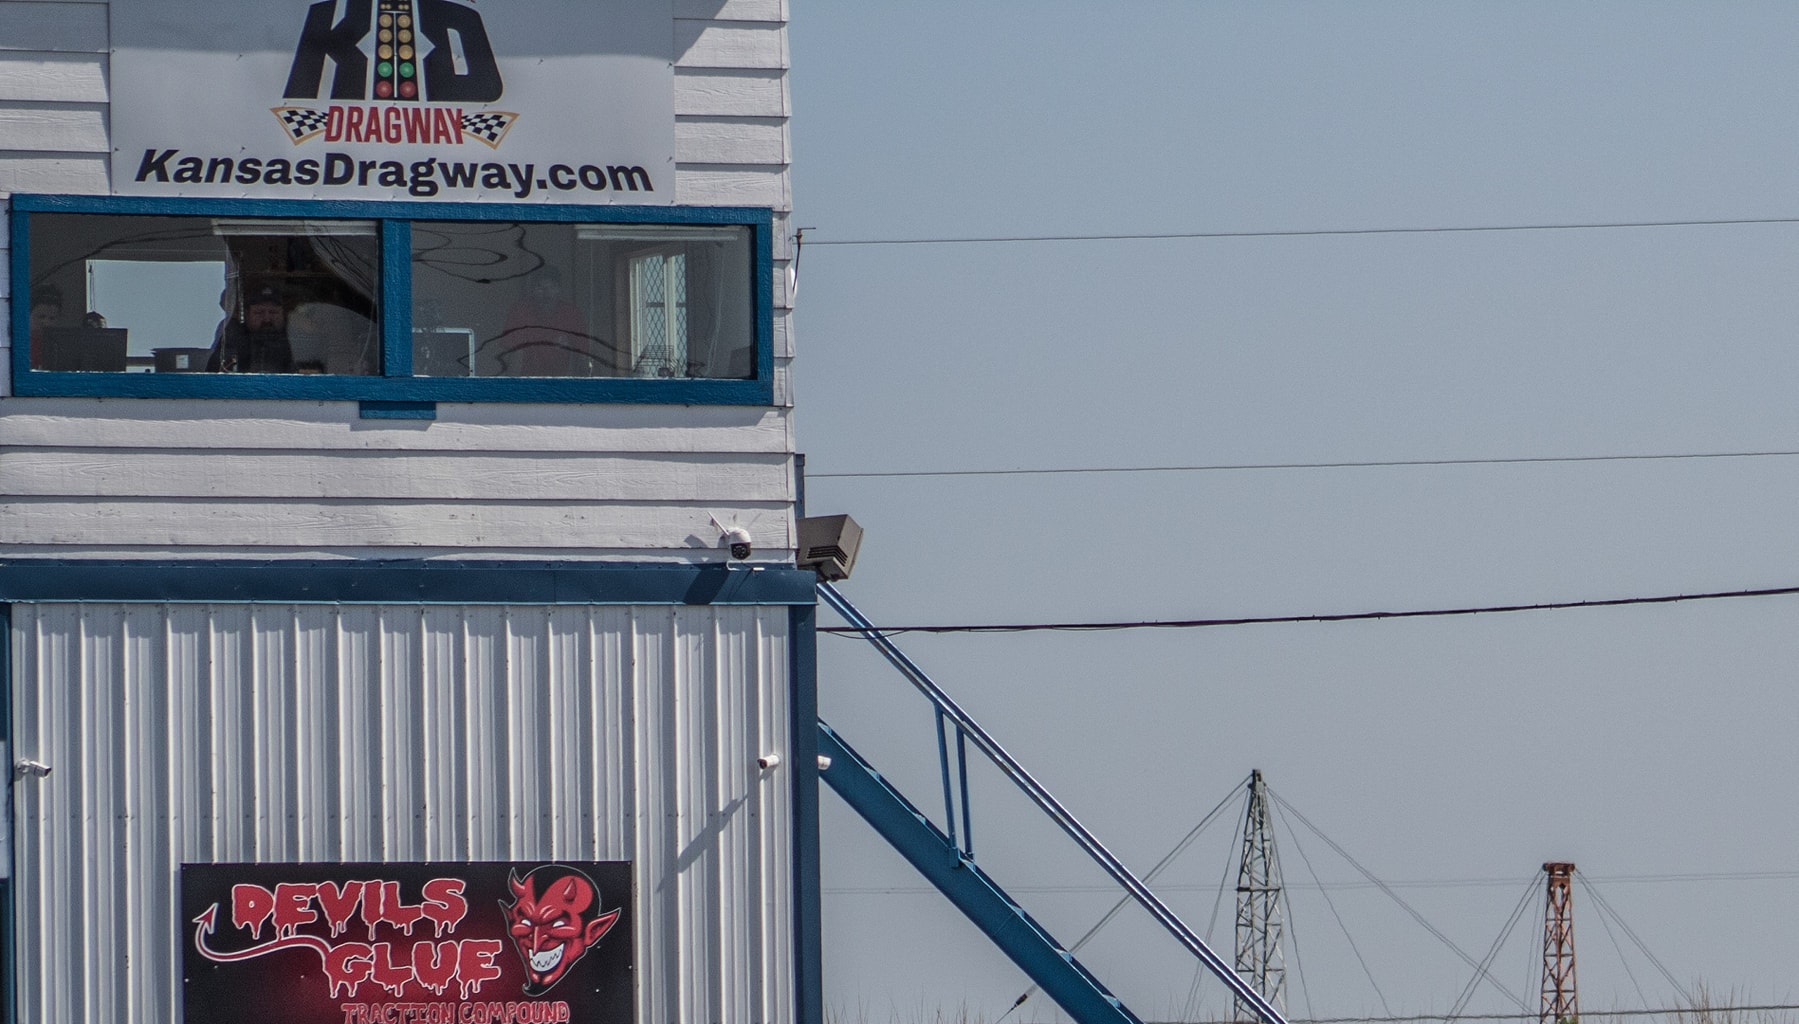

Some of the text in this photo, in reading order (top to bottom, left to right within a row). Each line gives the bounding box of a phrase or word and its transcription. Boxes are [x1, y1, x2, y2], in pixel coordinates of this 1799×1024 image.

[325, 106, 464, 144] DRAGWAY
[135, 148, 654, 198] KansasDragway.com
[231, 878, 468, 942] DEVILS
[327, 939, 502, 999] GLUE
[458, 1001, 570, 1024] COMPOUND
